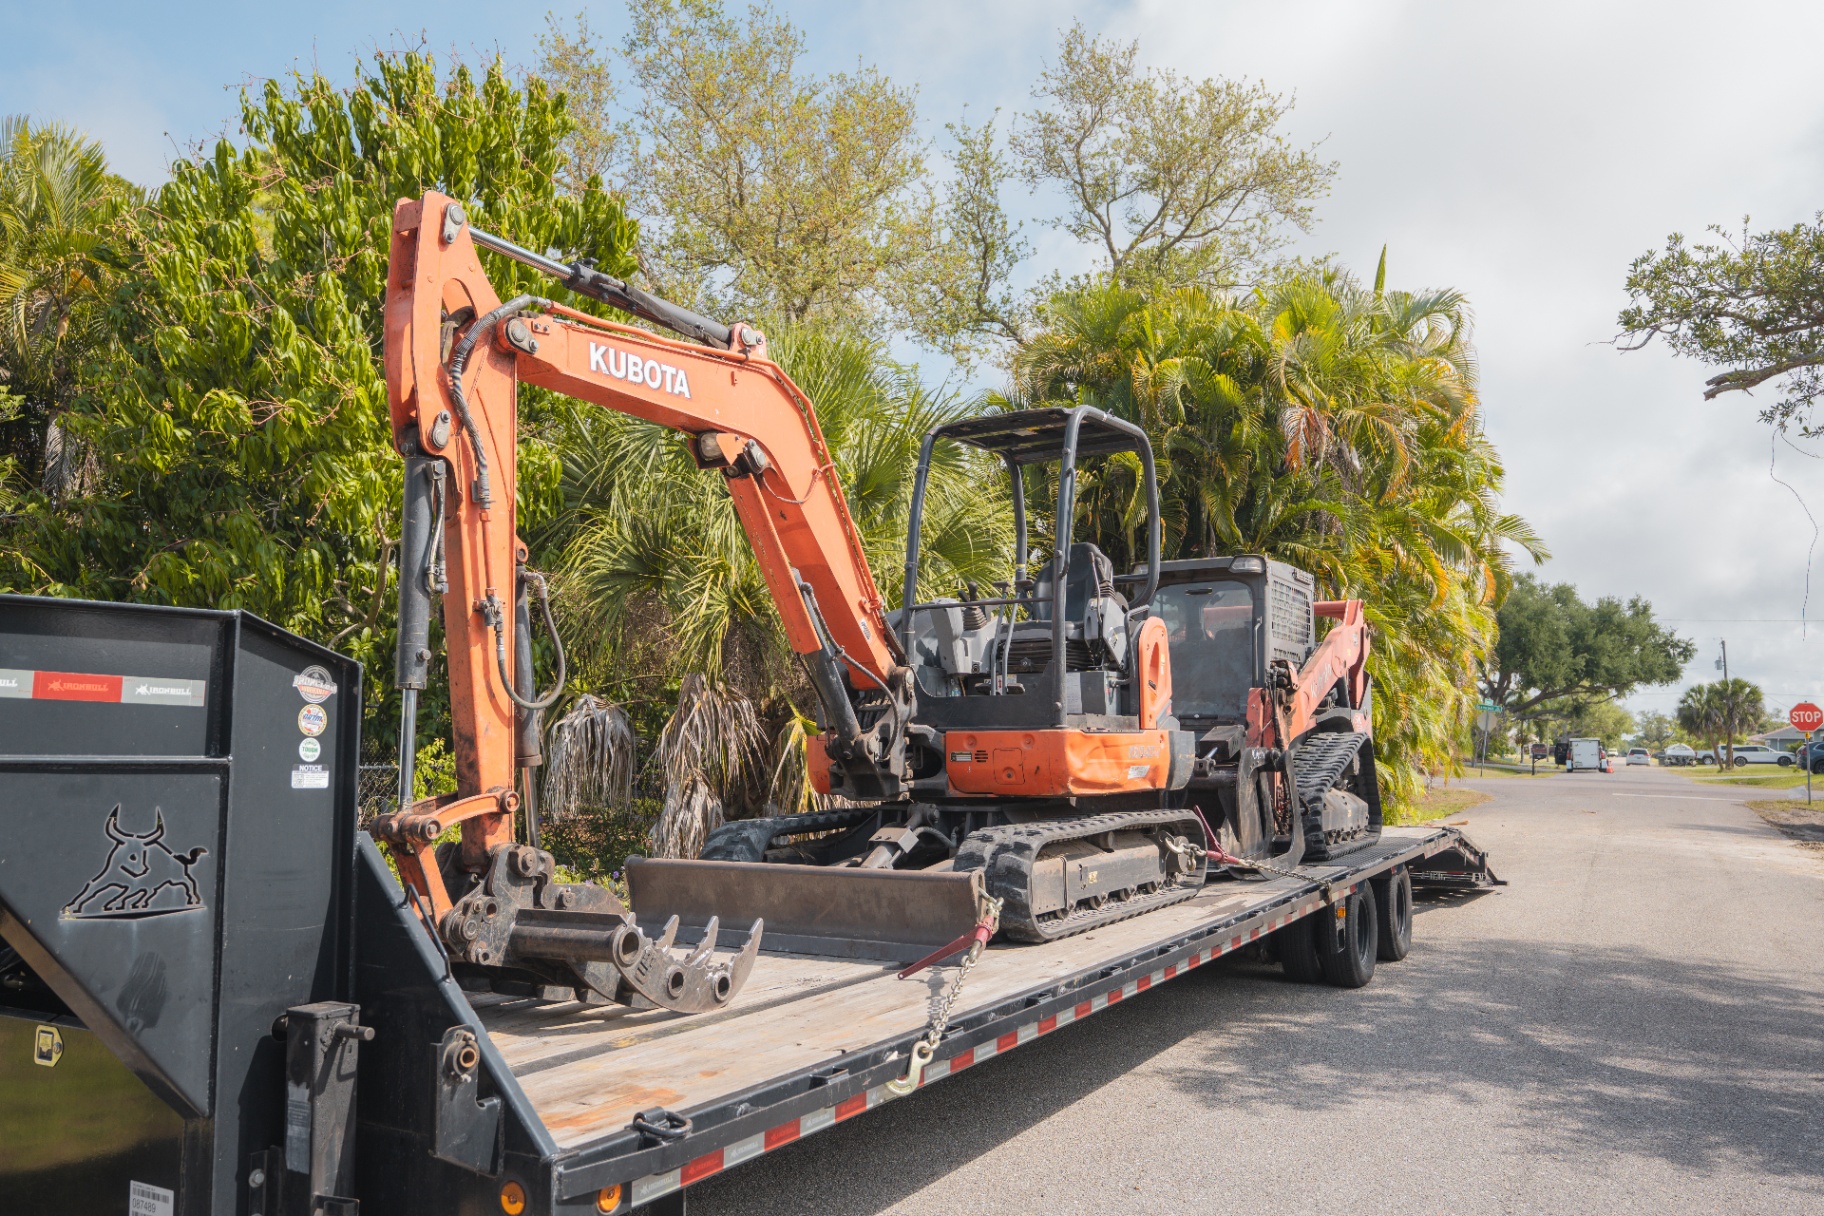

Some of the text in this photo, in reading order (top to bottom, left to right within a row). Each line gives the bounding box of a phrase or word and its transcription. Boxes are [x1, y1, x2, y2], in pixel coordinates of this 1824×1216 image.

[589, 341, 691, 399] KUBOTA
[63, 682, 109, 692] IRONBULL
[149, 685, 192, 696] IRONBULL
[1791, 711, 1822, 723] STOP
[299, 764, 322, 772] NOTICE
[132, 1197, 156, 1213] 087489
